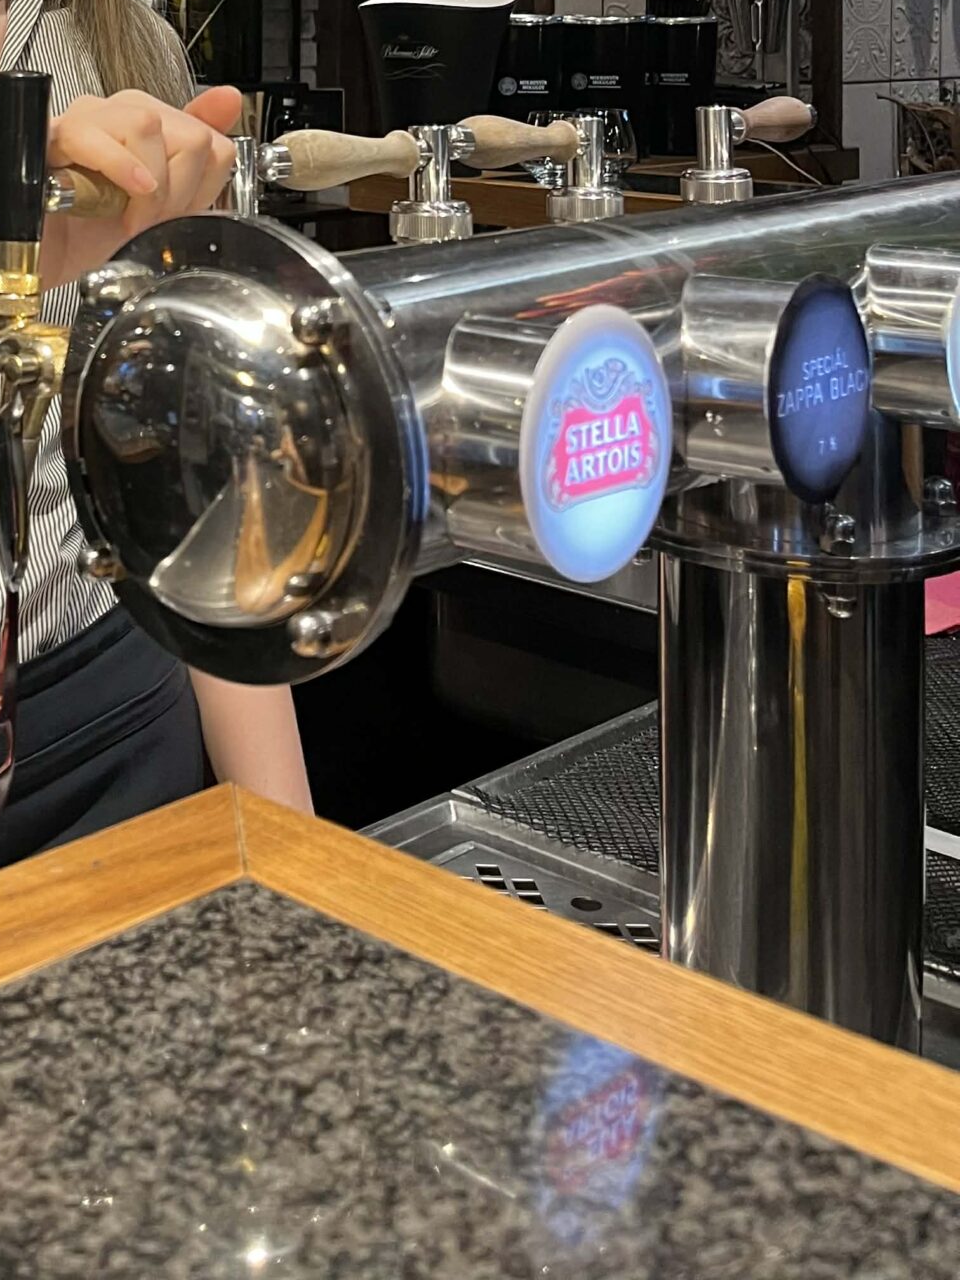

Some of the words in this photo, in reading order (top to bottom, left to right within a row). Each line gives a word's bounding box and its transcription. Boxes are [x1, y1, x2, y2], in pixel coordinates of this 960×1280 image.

[802, 347, 849, 380] SPECIAL
[777, 382, 824, 418] ZAPPA
[565, 413, 641, 447] STELLA
[565, 442, 642, 486] ARTOIS
